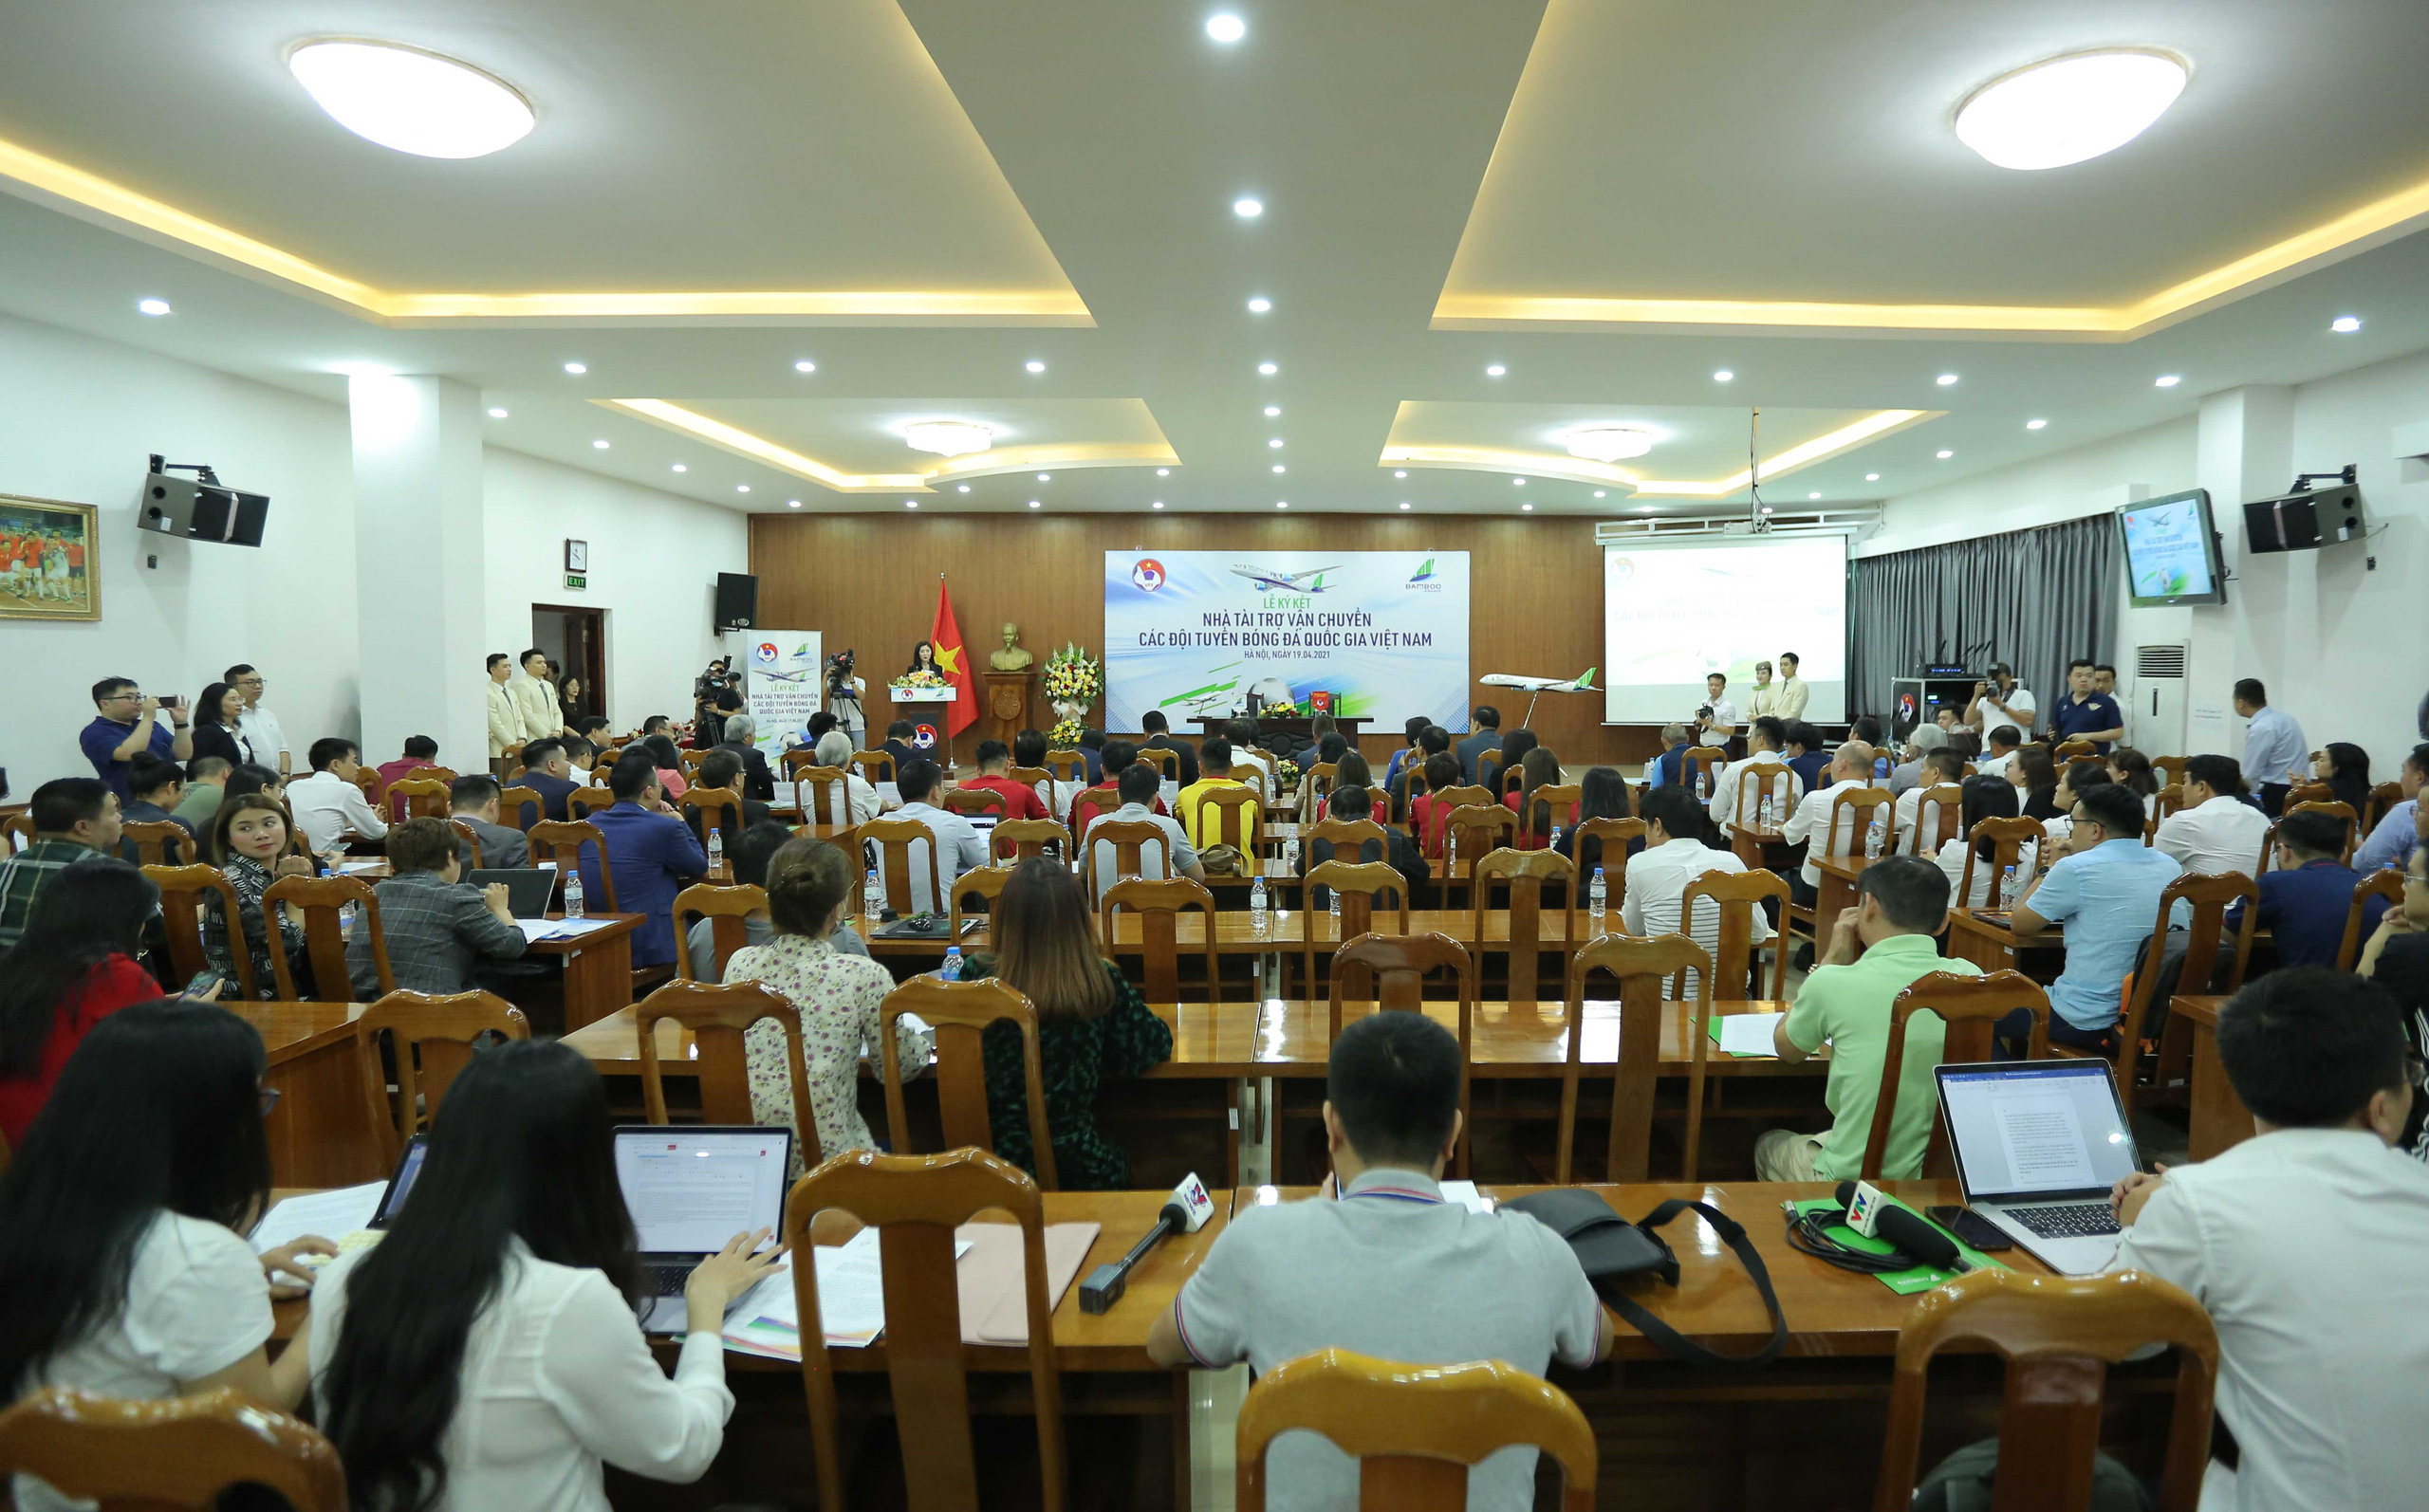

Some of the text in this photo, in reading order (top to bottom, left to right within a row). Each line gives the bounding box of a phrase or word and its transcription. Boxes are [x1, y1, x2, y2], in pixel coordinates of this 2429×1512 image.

[569, 577, 584, 586] EXIT
[1264, 594, 1311, 609] LỄ KÝ KẾT
[1203, 607, 1371, 630] NHÀ TÀI TRỢ VẬN CHUYỂN
[1139, 627, 1432, 650] CÁC ĐỘI TUYỂN BÓNG ĐÁ QUỐC GIA VIỆT NAM
[1244, 649, 1254, 658] HÀ
[1256, 649, 1270, 660] NỘI,
[1272, 649, 1291, 658] NGÀY
[1184, 1193, 1196, 1216] NEWS
[1850, 1191, 1867, 1221] VTV
